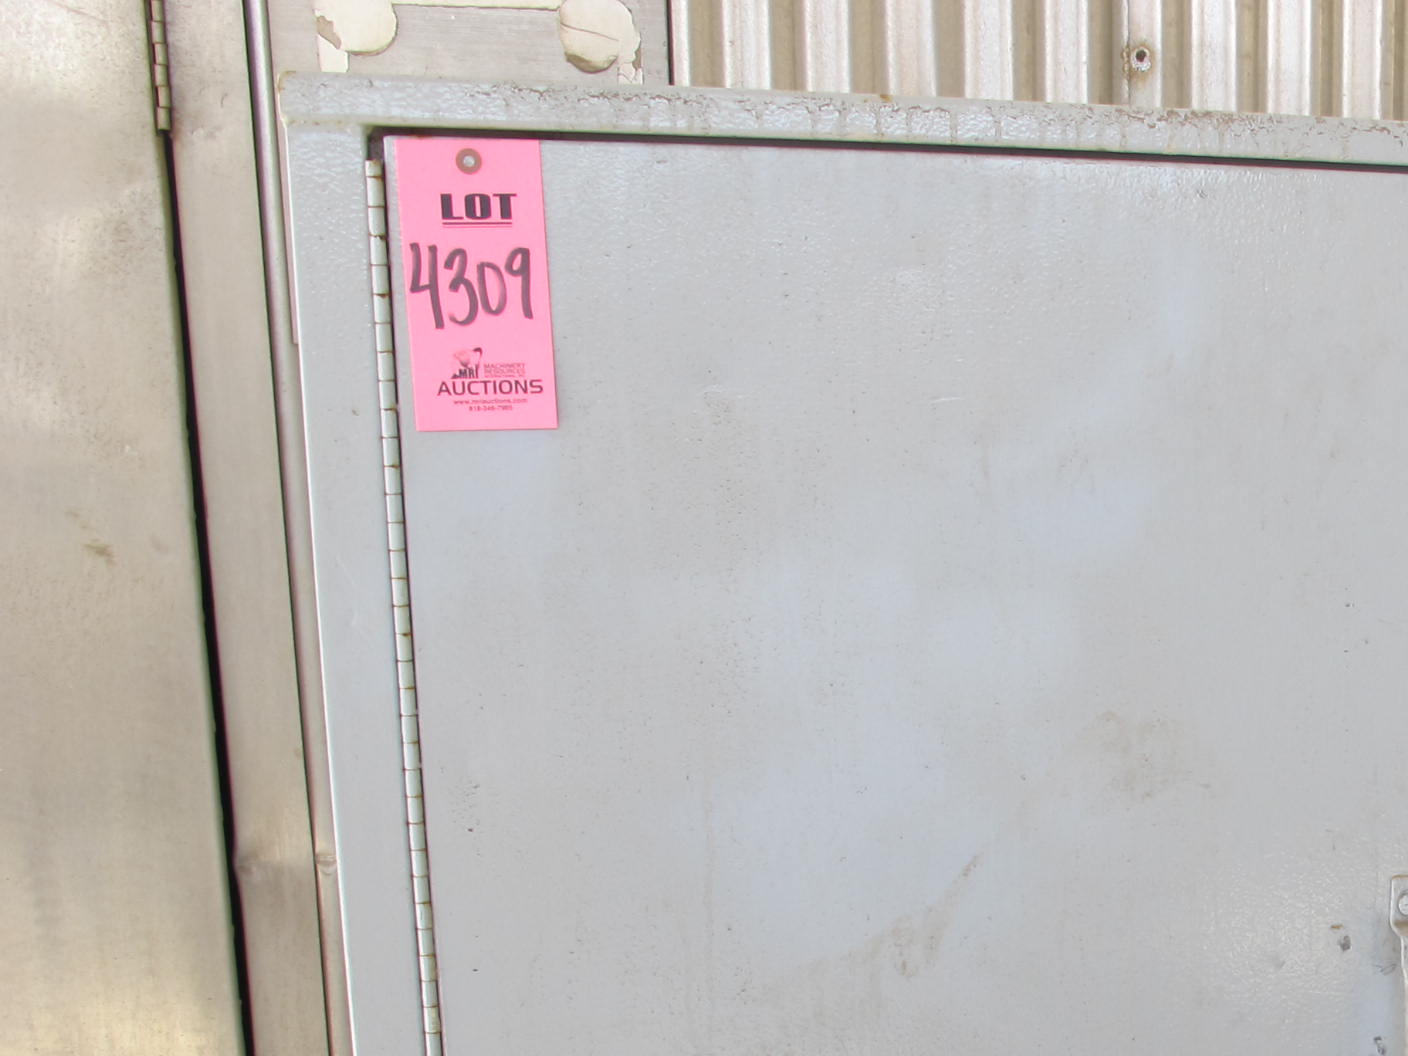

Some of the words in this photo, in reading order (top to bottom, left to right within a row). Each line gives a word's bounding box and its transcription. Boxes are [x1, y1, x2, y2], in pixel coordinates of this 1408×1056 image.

[440, 193, 517, 221] LOT
[409, 242, 534, 330] 4309
[437, 379, 544, 397] AUCTIONS
